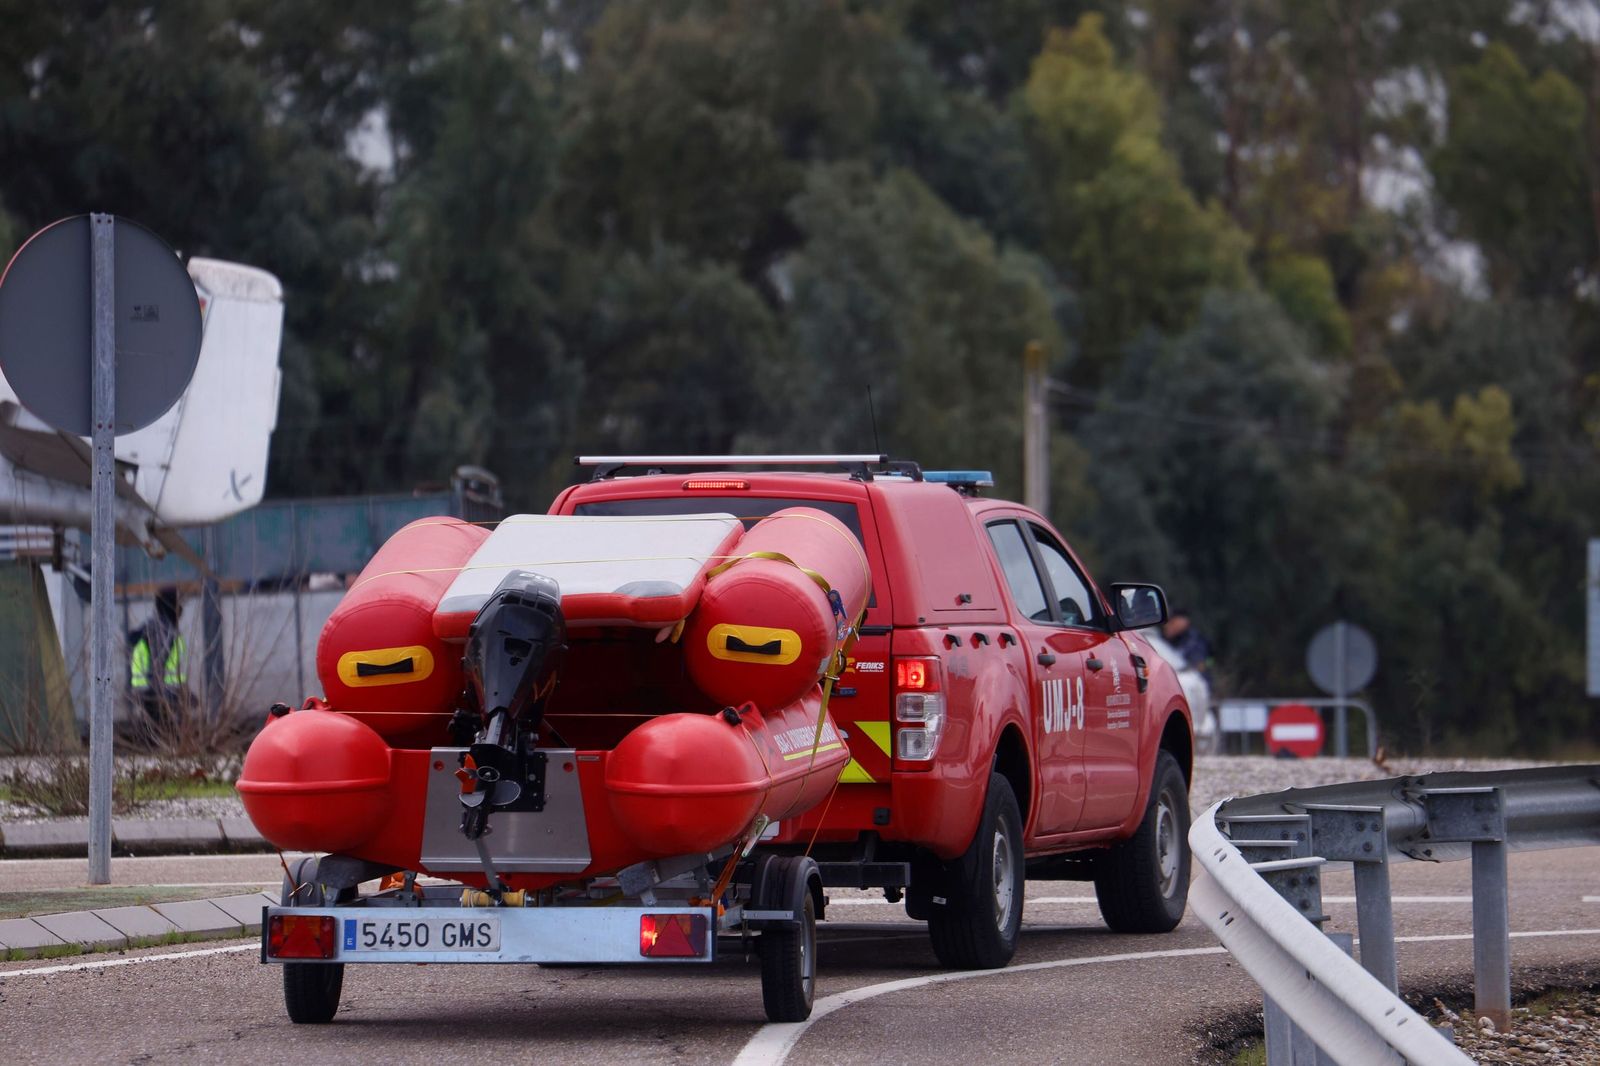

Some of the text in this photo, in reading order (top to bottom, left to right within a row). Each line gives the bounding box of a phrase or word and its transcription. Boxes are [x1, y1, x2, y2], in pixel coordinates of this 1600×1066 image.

[1042, 676, 1084, 734] UMJ-8
[362, 923, 429, 947] 5450
[442, 923, 492, 947] GMS
